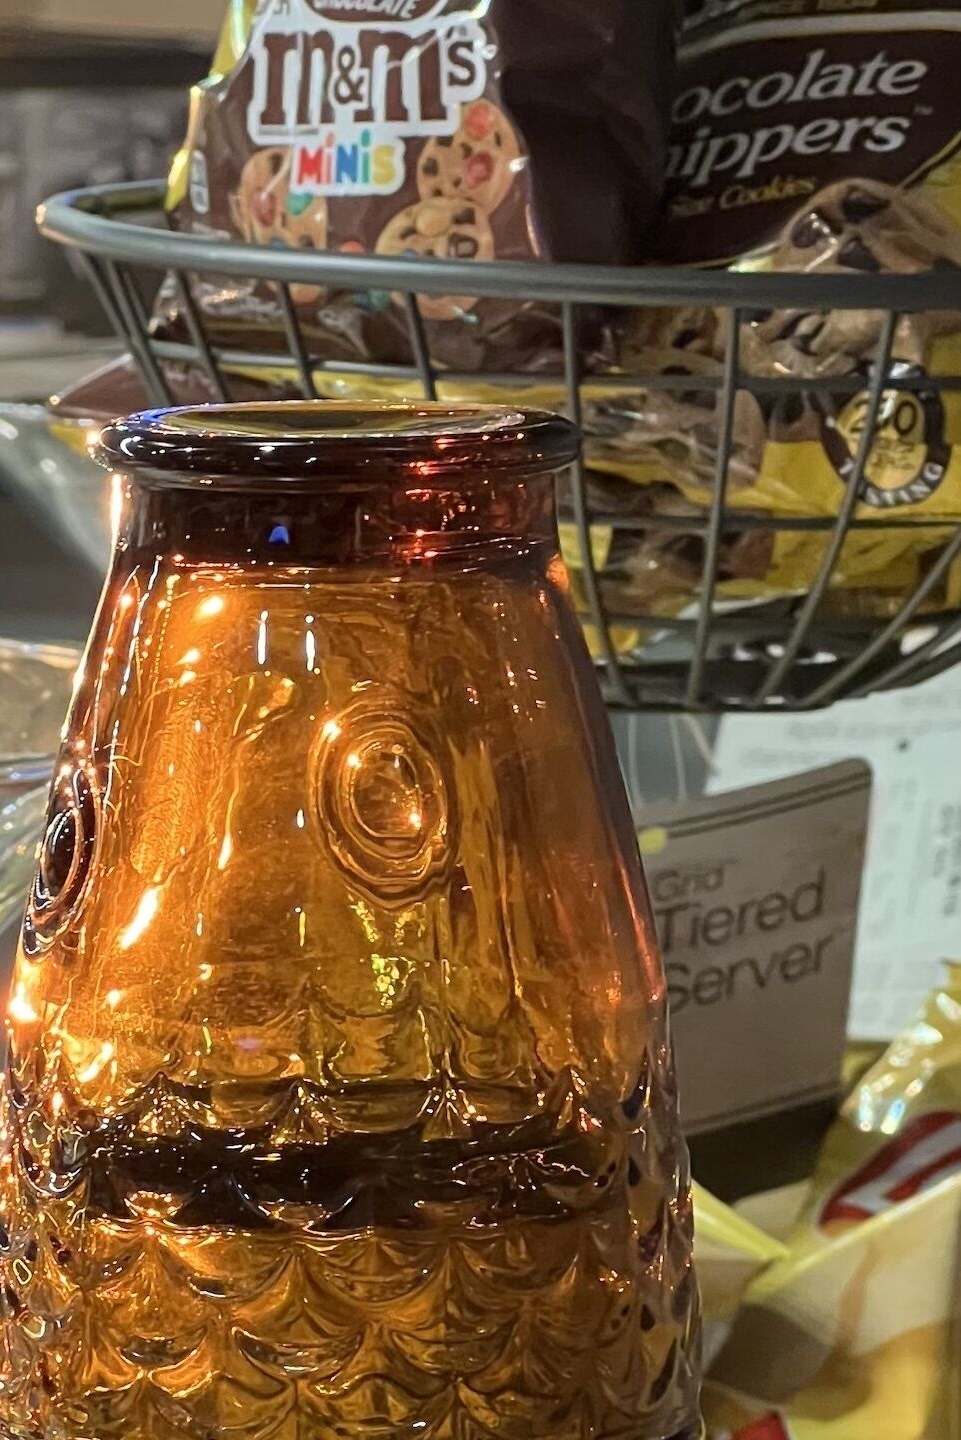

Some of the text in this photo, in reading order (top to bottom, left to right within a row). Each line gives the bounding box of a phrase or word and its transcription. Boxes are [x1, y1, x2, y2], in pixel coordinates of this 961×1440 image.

[672, 49, 927, 124] ocolate
[666, 116, 910, 187] ippers
[654, 864, 825, 952] Tiered
[665, 934, 835, 1014] Server
